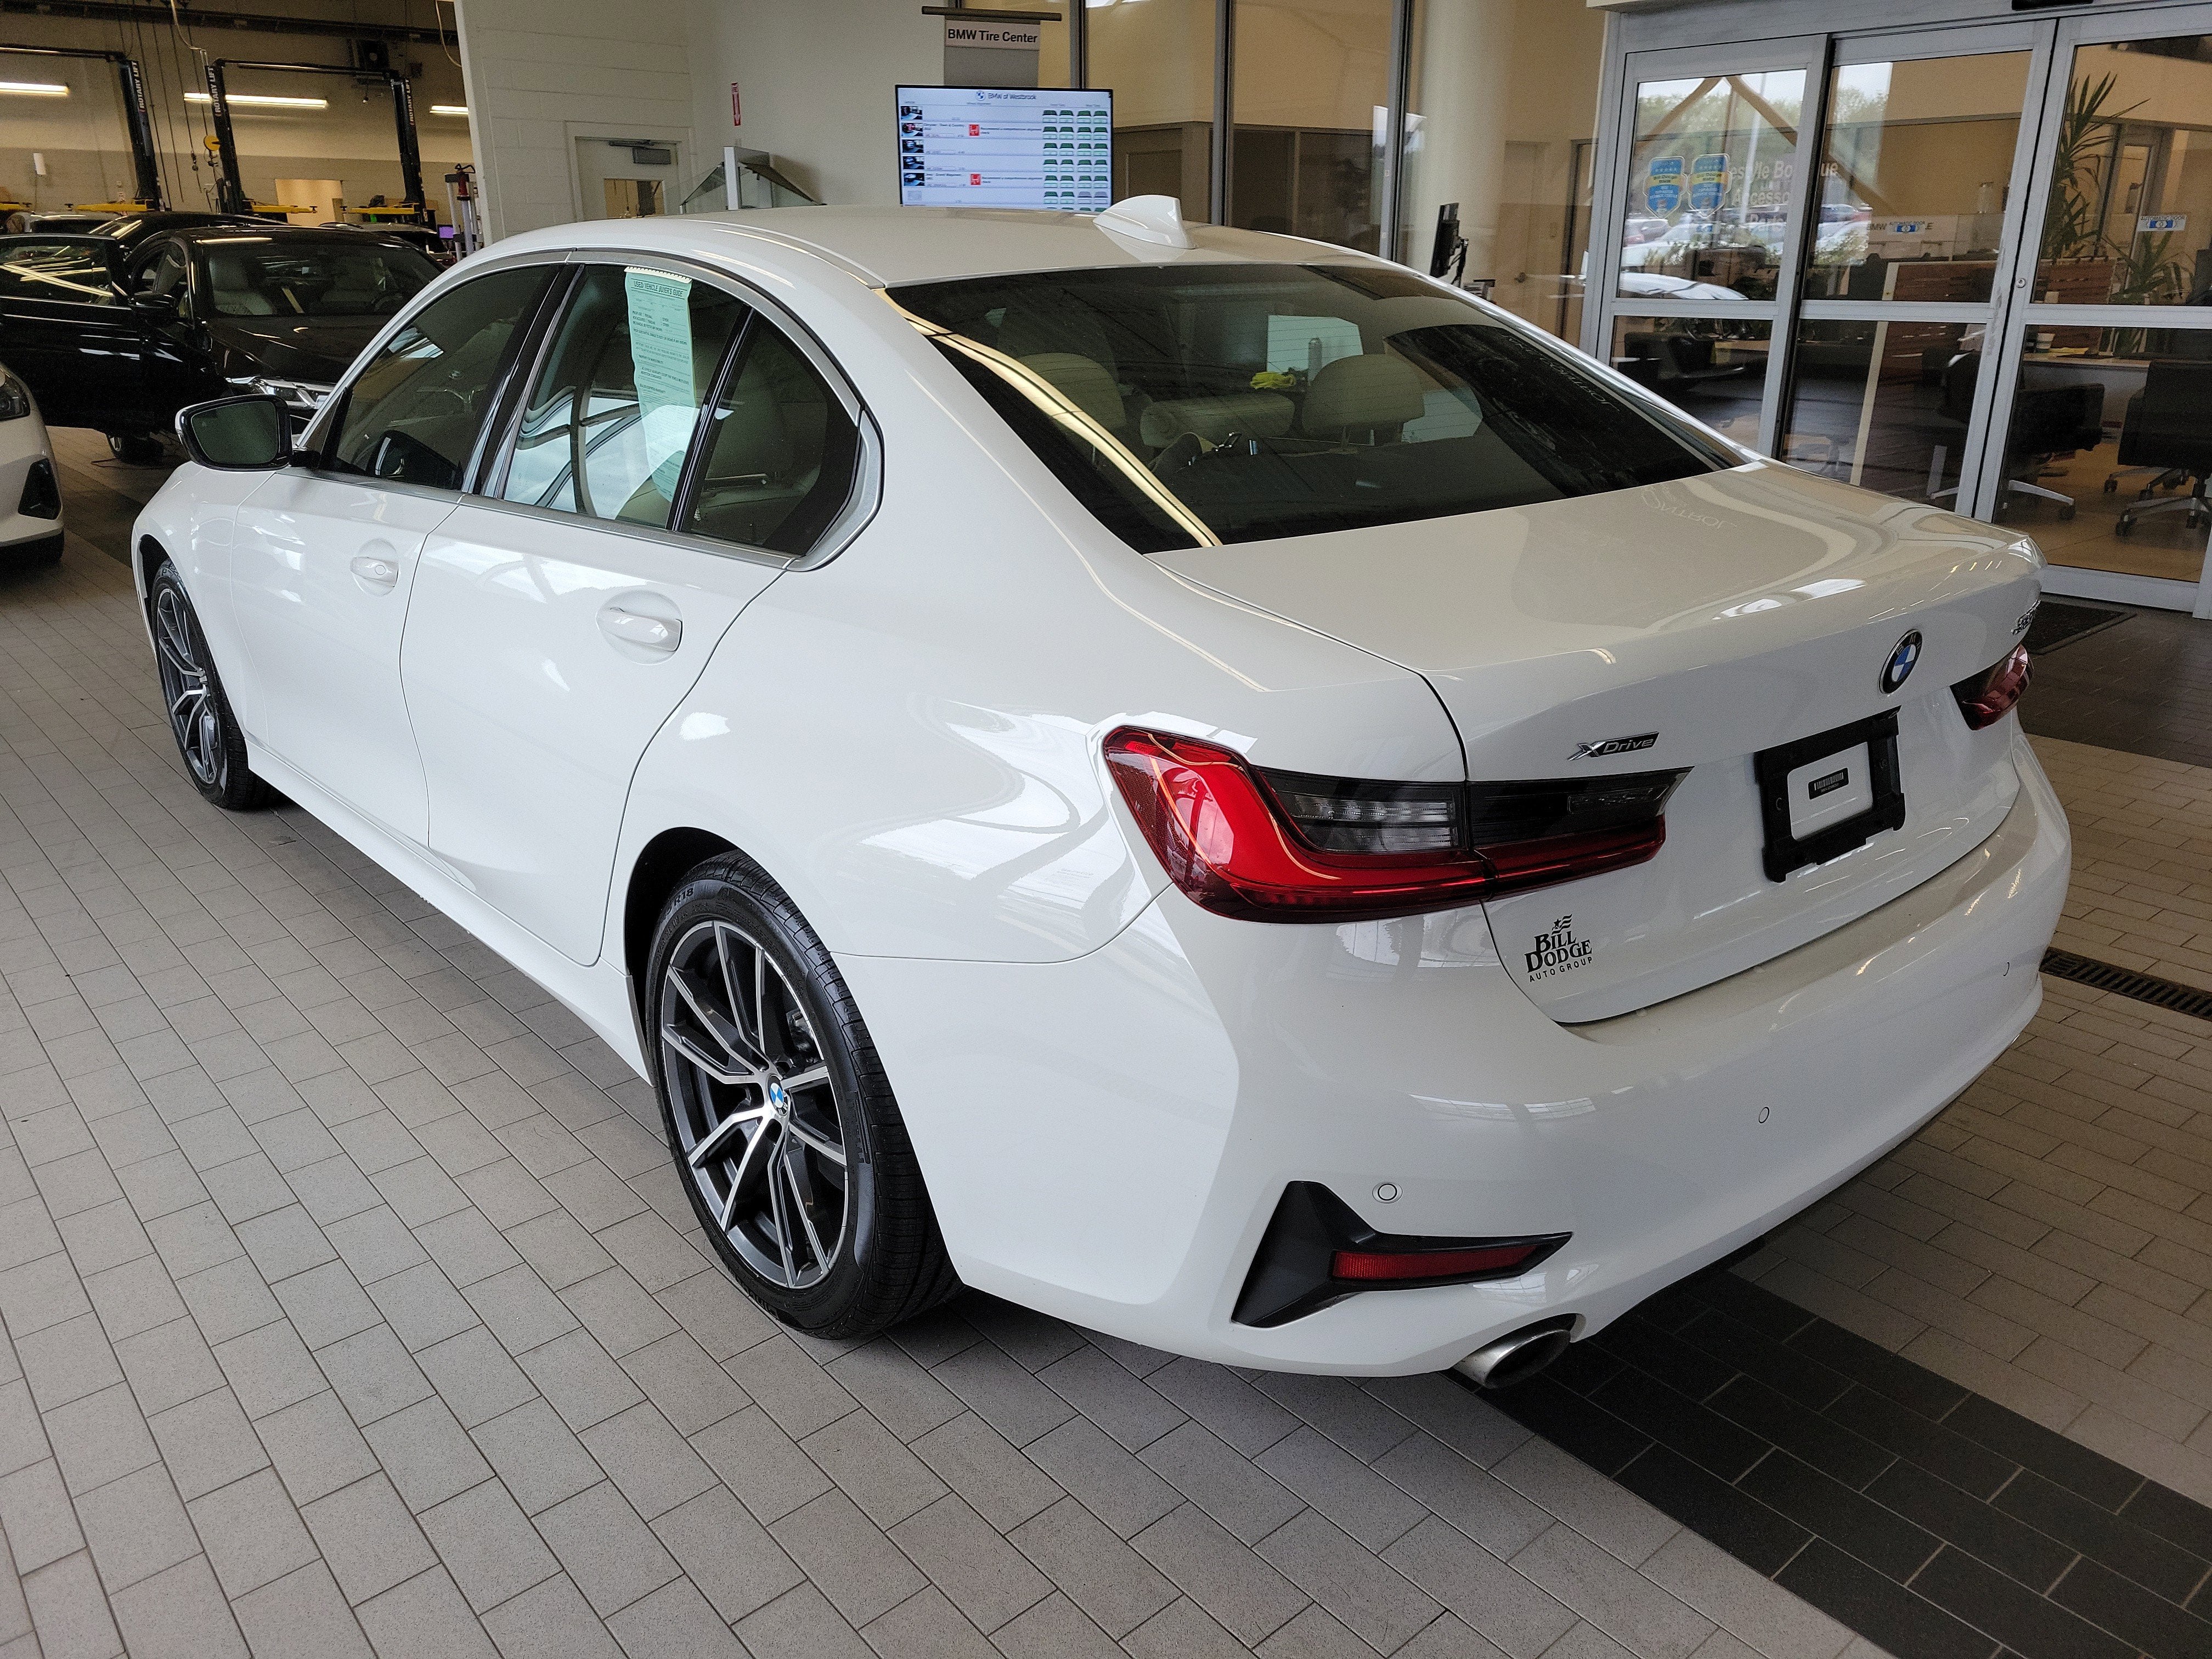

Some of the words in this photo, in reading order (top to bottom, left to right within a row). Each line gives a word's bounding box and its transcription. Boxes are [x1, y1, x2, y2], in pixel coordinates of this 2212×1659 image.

[948, 29, 977, 40] BMW
[979, 30, 999, 41] Tire
[1002, 31, 1038, 43] Center
[131, 61, 139, 77] LIFT
[134, 78, 145, 109] ROTARY
[210, 84, 221, 112] ROTARY
[634, 280, 644, 289] USED
[645, 283, 658, 292] VEHICLE
[673, 289, 683, 297] GUIDE
[1534, 931, 1577, 953] BILL
[1525, 940, 1592, 973] DODGE
[1530, 968, 1556, 982] AUTO
[1559, 957, 1592, 973] GROUP
